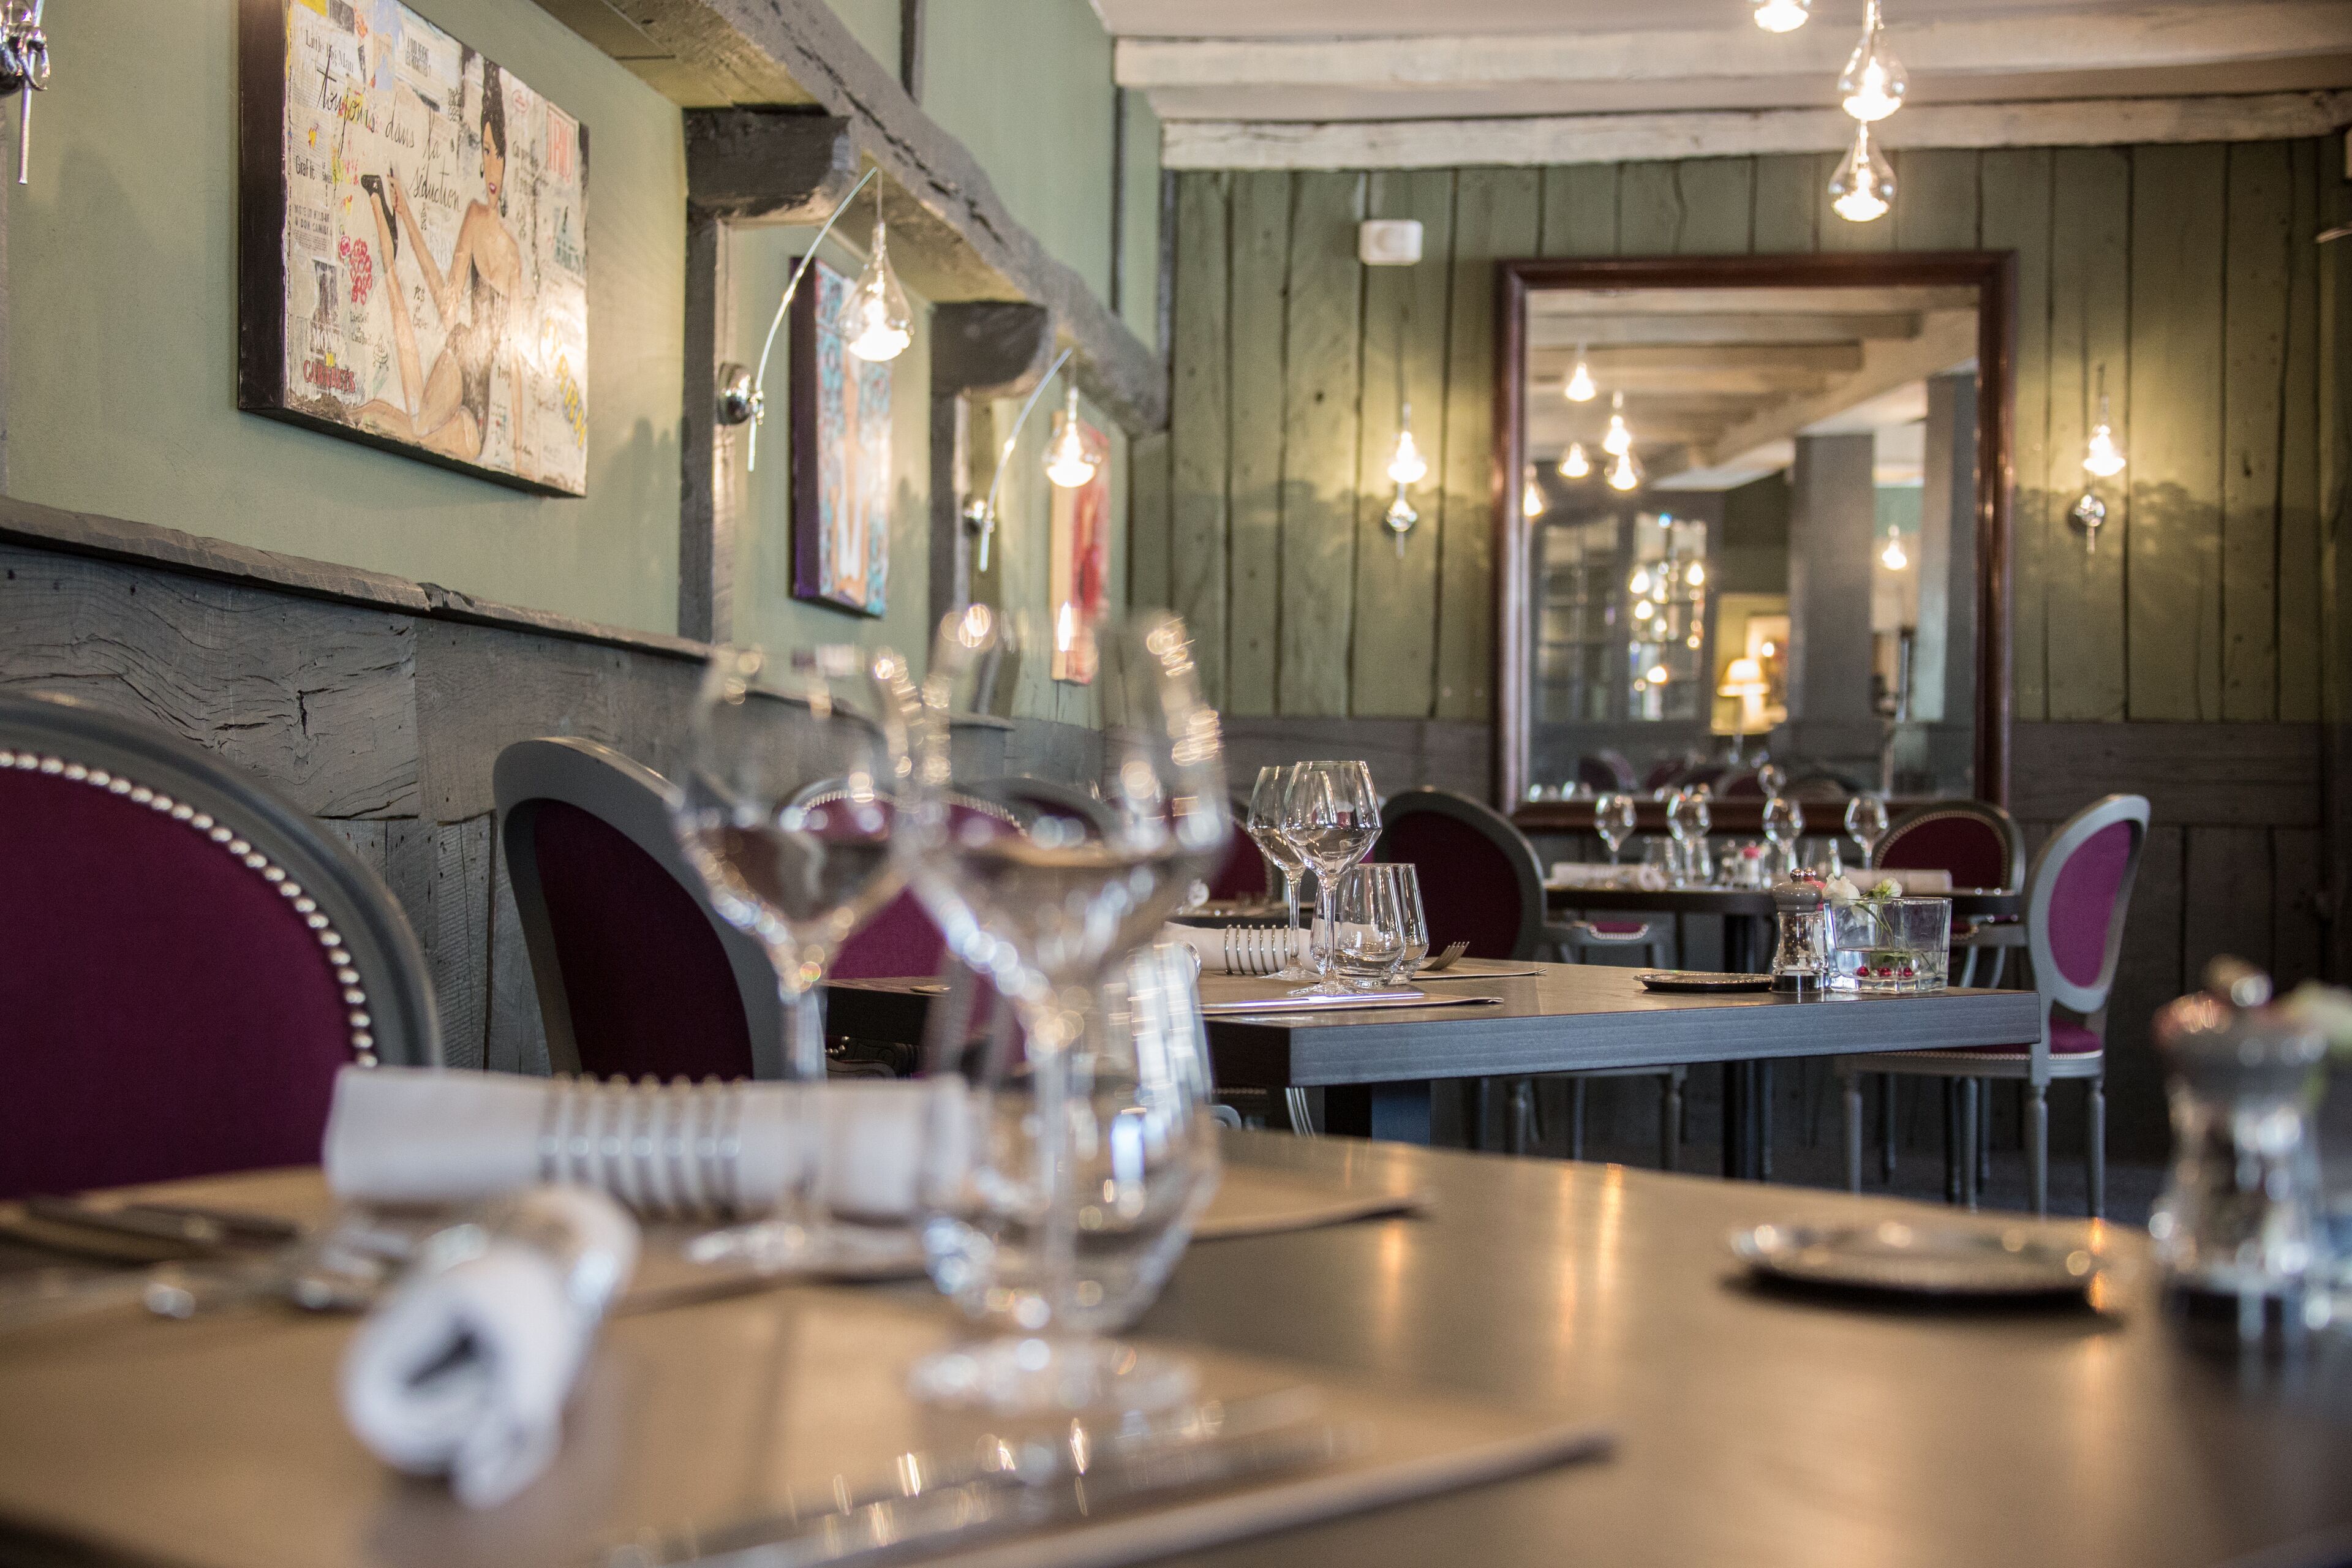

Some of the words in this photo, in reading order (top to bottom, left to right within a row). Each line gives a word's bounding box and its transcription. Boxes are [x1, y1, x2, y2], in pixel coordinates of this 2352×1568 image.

[306, 29, 324, 53] Little
[339, 50, 354, 73] Man
[316, 45, 375, 158] toujours
[385, 92, 414, 148] dans
[423, 107, 441, 161] la
[409, 156, 461, 212] séduction
